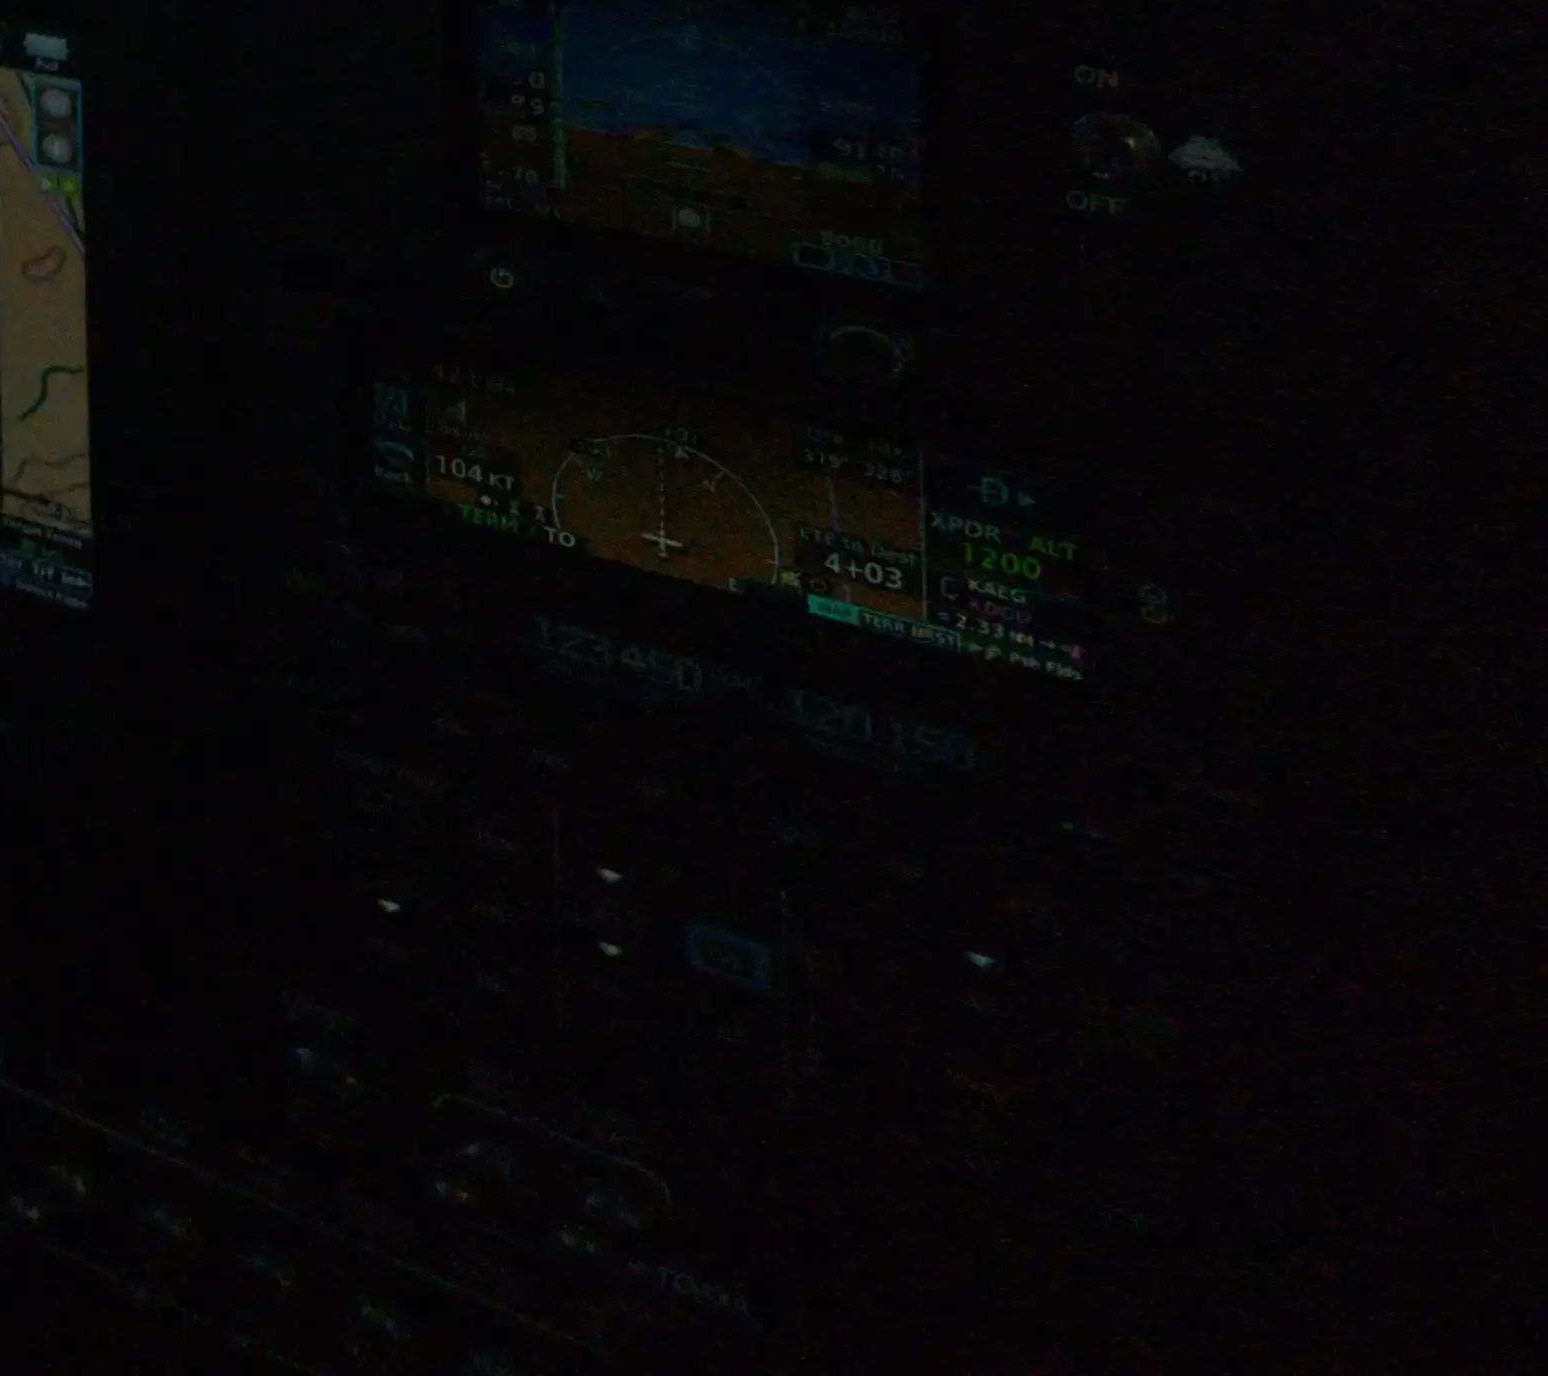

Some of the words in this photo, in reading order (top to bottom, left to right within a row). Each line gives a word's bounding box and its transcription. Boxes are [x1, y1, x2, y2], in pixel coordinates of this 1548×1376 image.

[435, 453, 484, 484] 104
[489, 472, 516, 491] KT
[543, 525, 576, 549] TO
[929, 509, 1002, 545] XPDR
[823, 551, 905, 591] 4+03
[962, 541, 1042, 581] 1200
